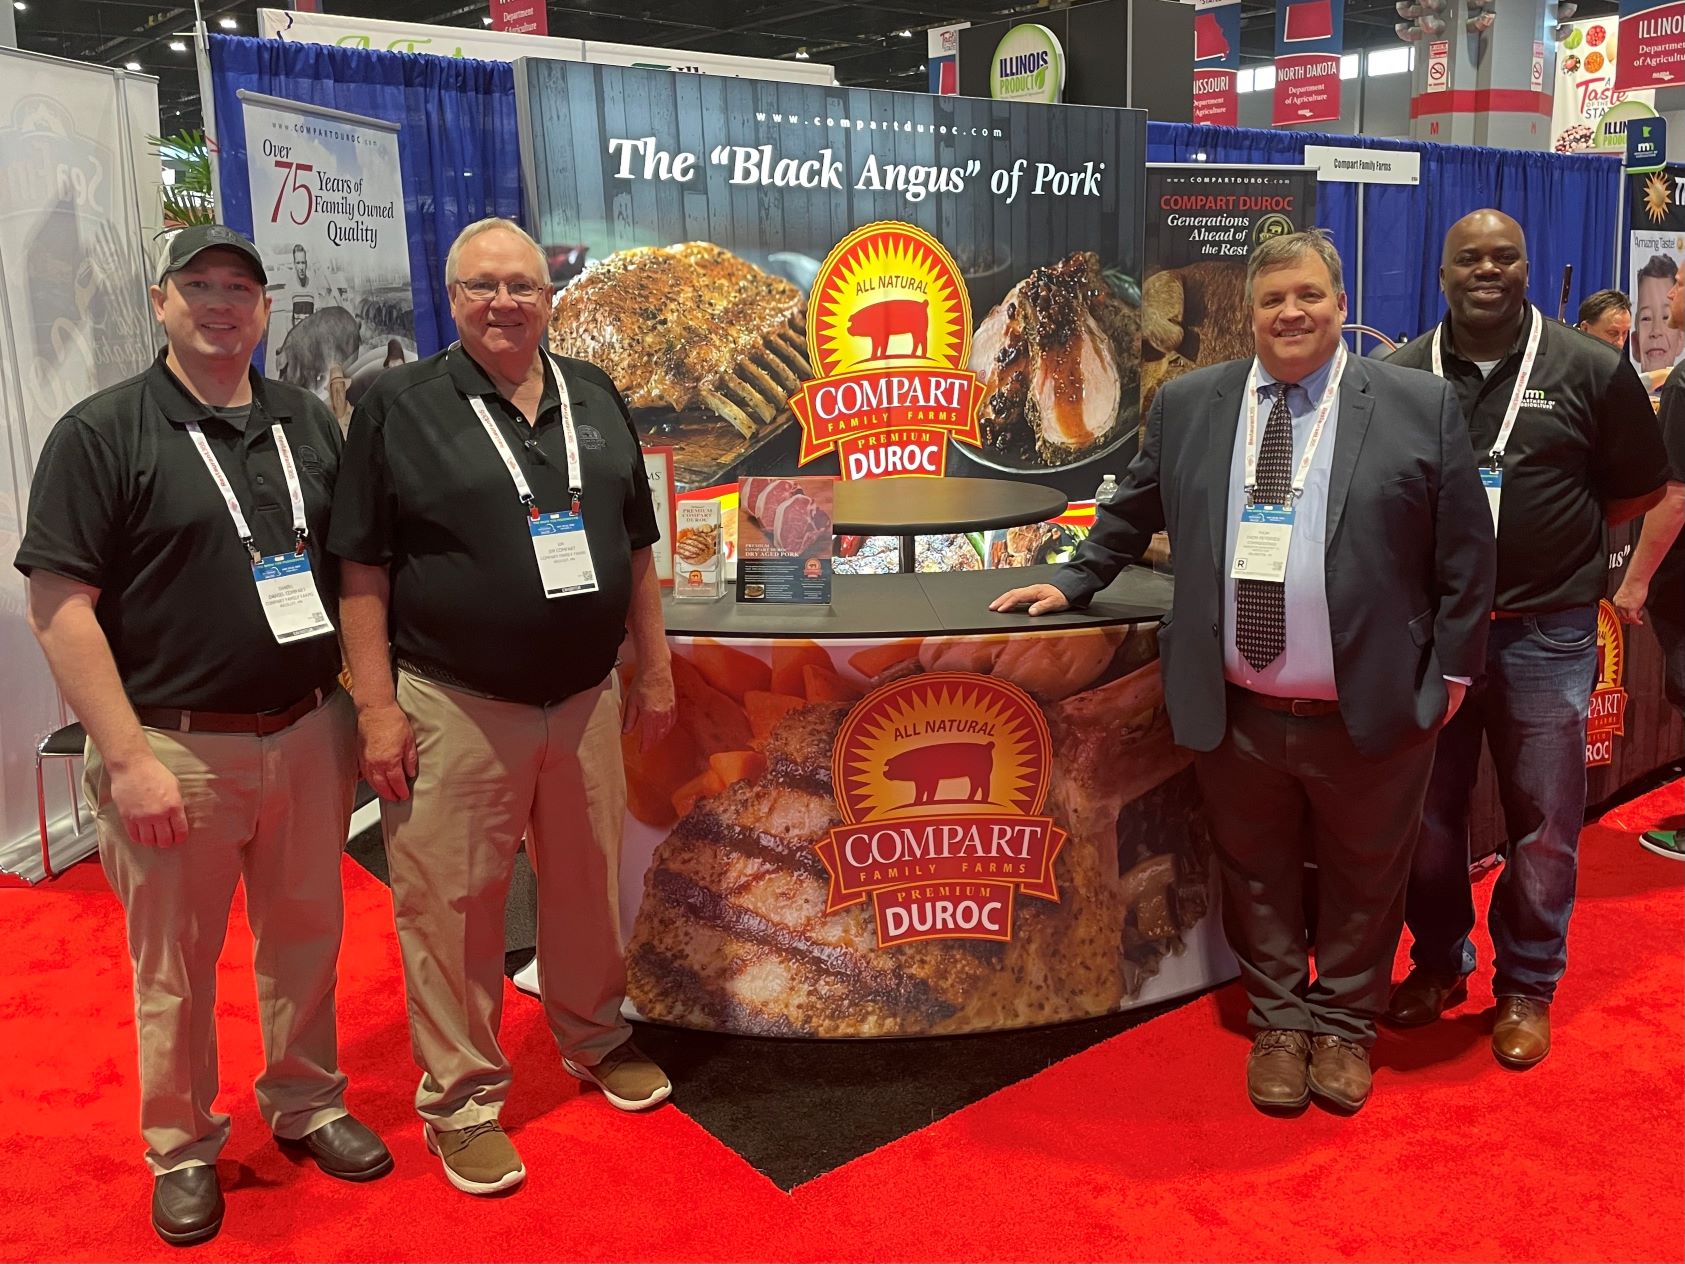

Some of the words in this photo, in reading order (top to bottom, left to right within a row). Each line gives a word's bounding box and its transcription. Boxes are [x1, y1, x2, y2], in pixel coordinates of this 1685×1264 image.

[1000, 51, 1048, 78] ILLINOIS
[1278, 66, 1304, 81] NORTH
[1306, 61, 1337, 78] DAKOTA
[1634, 57, 1644, 66] of
[1000, 74, 1035, 95] PRODUCT
[1288, 84, 1325, 95] Department
[1293, 94, 1328, 105] Agriculture
[756, 111, 1004, 138] www.compartduroc.com
[263, 139, 291, 159] Over
[609, 137, 695, 181] The
[710, 144, 844, 190] “Black
[853, 153, 982, 203] Angus”
[990, 158, 1029, 205] of
[1333, 158, 1359, 170] Compart
[1359, 159, 1375, 172] Family
[1376, 160, 1392, 172] Farms
[271, 160, 313, 225] 75
[316, 171, 352, 194] Years
[353, 178, 364, 197] of
[314, 195, 355, 220] Family
[357, 200, 394, 219] Owned
[1160, 195, 1236, 211] COMPART
[1239, 196, 1294, 212] DUROC
[1167, 213, 1250, 228] Generations
[327, 220, 377, 249] Quality
[1189, 228, 1234, 242] Ahead
[1235, 229, 1249, 243] of
[1201, 243, 1218, 254] the
[1219, 243, 1249, 256] Rest
[855, 277, 875, 296] ALL
[878, 274, 929, 296] NATURAL
[814, 376, 969, 420] COMPART
[827, 412, 890, 433] FAMILY
[907, 410, 957, 422] FARMS
[857, 431, 931, 449] PREMIUM
[848, 443, 939, 481] DUROC
[1237, 559, 1245, 568] R
[893, 722, 920, 742] ALL
[924, 718, 997, 738] NATURAL
[844, 824, 1041, 868] COMPART
[860, 864, 937, 882] FAMILY
[962, 862, 1026, 874] FARMS
[897, 886, 991, 902] PREMIUM
[885, 900, 1002, 937] DUROC
